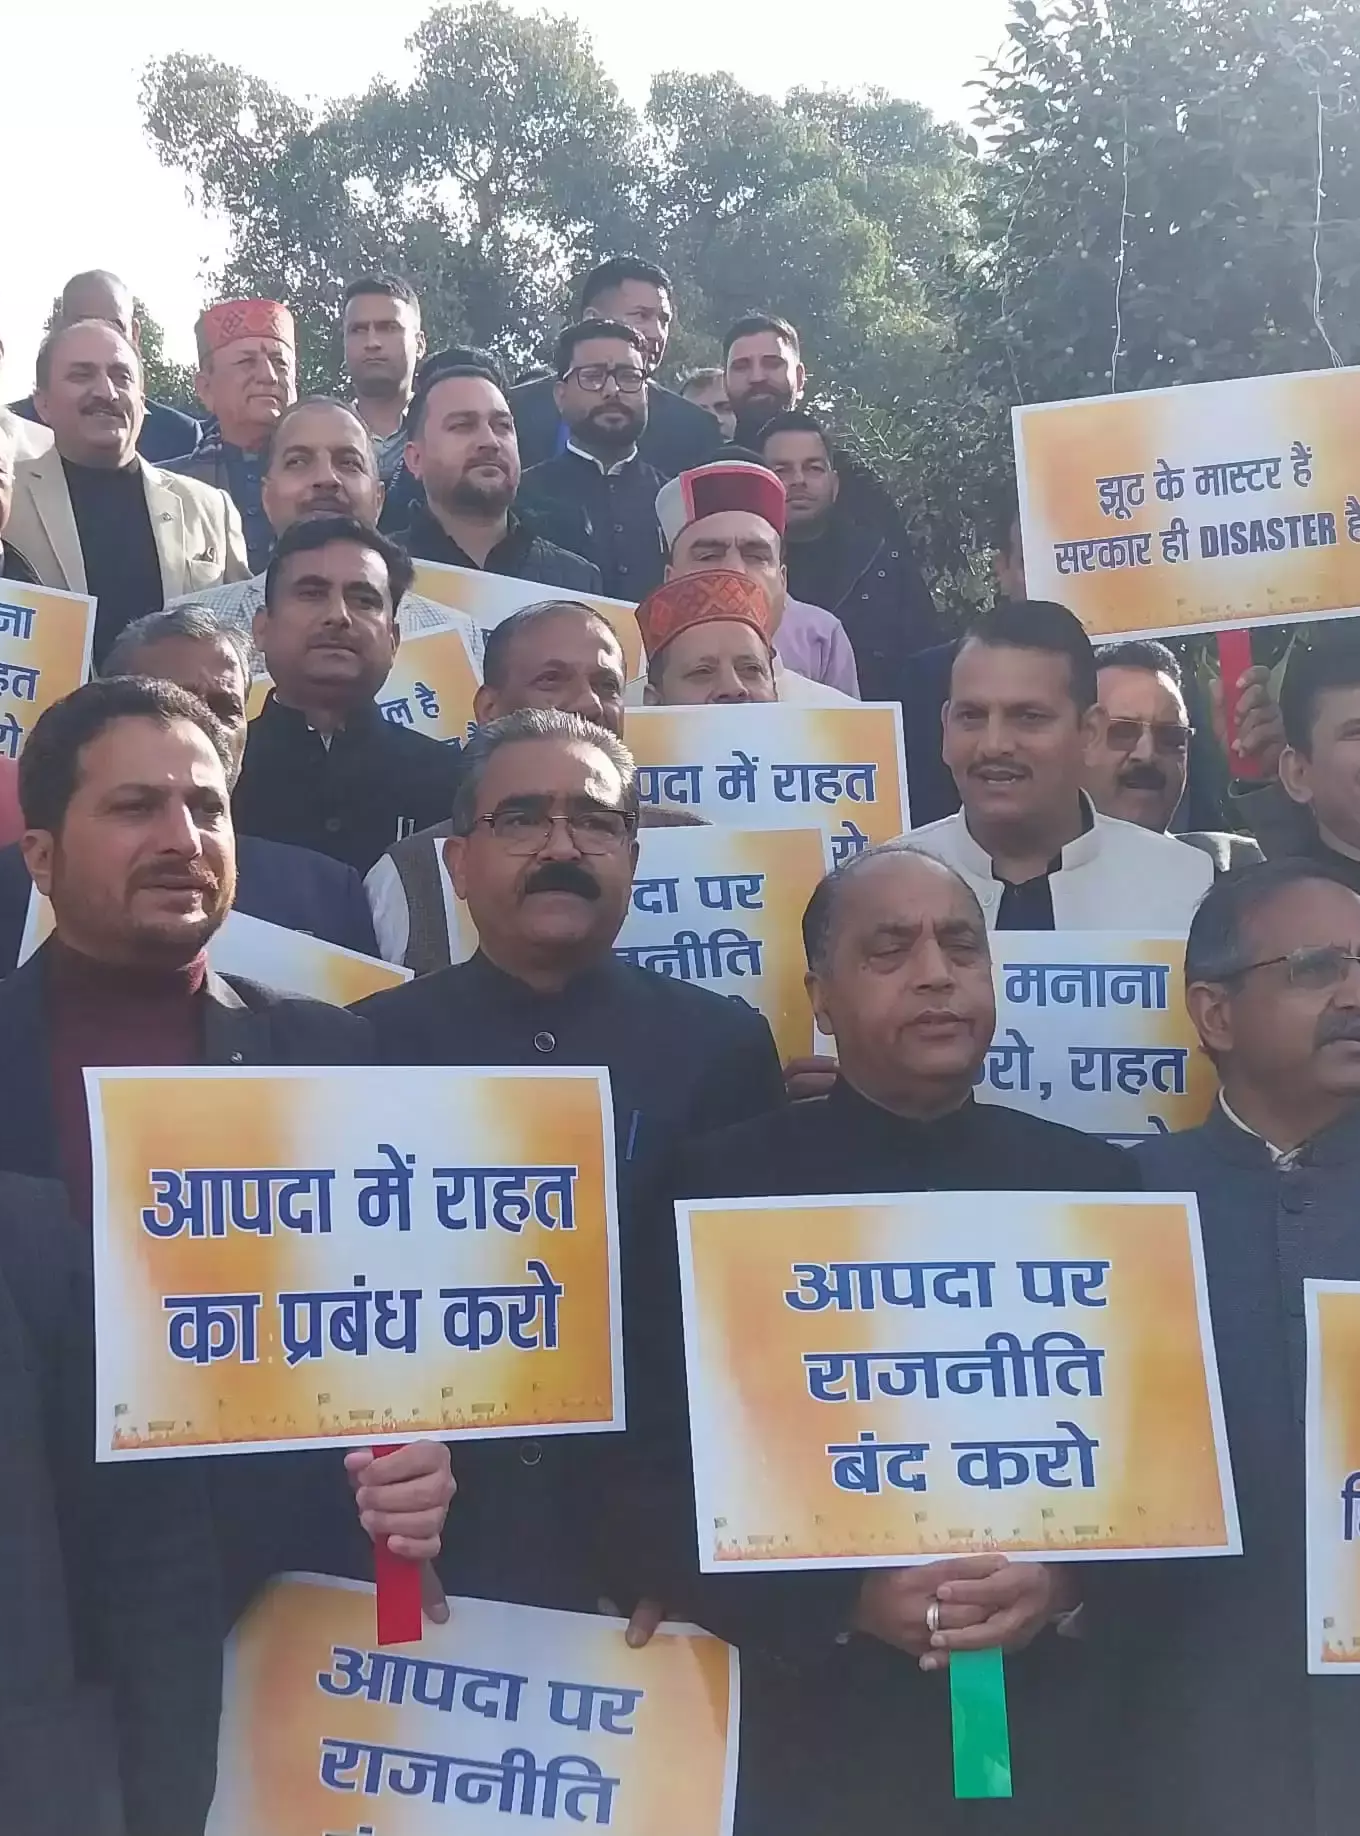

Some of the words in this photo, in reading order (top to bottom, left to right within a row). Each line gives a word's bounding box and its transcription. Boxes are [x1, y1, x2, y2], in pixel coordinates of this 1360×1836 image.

[1096, 474, 1144, 519] झूठ
[1153, 458, 1185, 502] के
[1193, 457, 1282, 497] मास्टर
[1290, 440, 1312, 487] हैं
[1054, 533, 1152, 575] सरकार
[1160, 517, 1189, 563] ही
[1200, 513, 1337, 558] DISASTER
[414, 681, 440, 719] है
[637, 765, 704, 805] पदा
[715, 751, 759, 803] में
[771, 763, 878, 804] राहत
[695, 874, 765, 911] पर
[1003, 963, 1170, 1009] मनाना
[980, 1028, 1052, 1101] रो,
[1068, 1047, 1188, 1096] राहत
[143, 1168, 335, 1238] आपदा
[354, 1144, 416, 1231] में
[433, 1166, 577, 1231] राहत
[166, 1293, 261, 1364] का
[280, 1275, 421, 1365] प्रबंध
[440, 1262, 562, 1349] करो
[785, 1262, 994, 1311] आपदा
[1017, 1261, 1110, 1307] पर
[804, 1332, 1105, 1401] राजनीति
[828, 1433, 929, 1494] बंद
[951, 1422, 1099, 1489] करो
[318, 1647, 528, 1721] आपदा
[548, 1680, 644, 1735] पर
[320, 1738, 621, 1824] राजनीति
